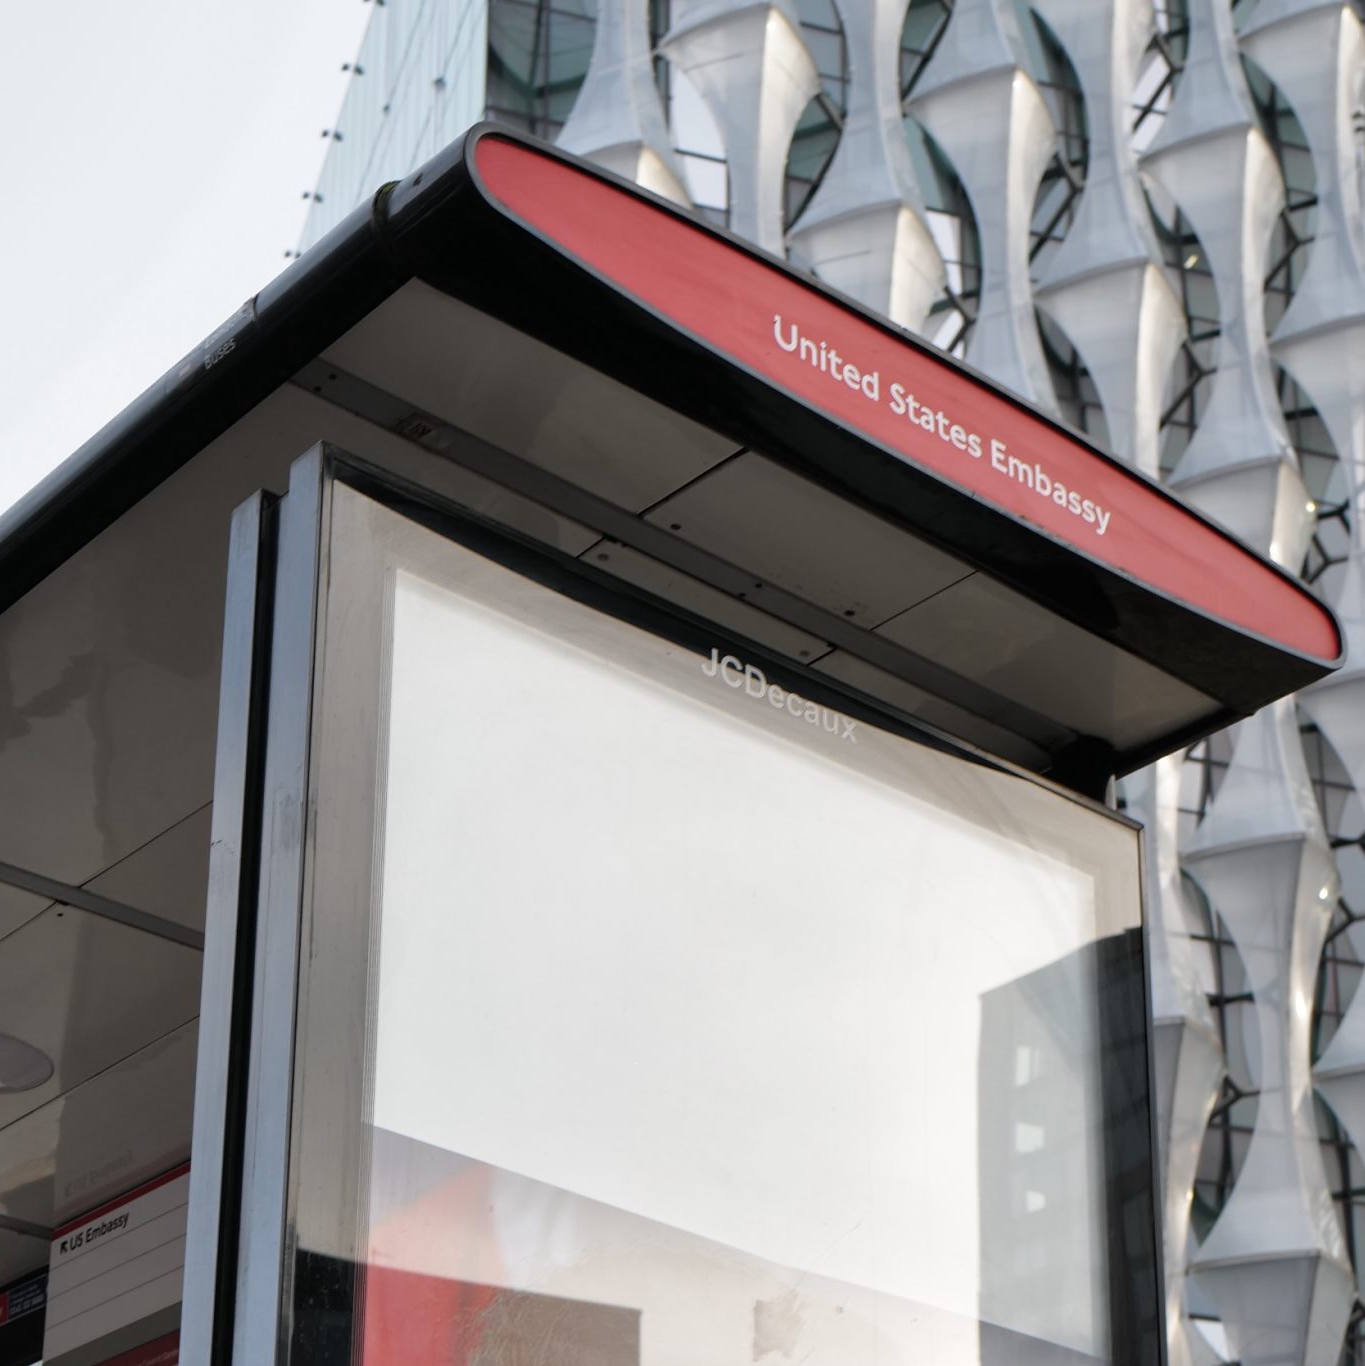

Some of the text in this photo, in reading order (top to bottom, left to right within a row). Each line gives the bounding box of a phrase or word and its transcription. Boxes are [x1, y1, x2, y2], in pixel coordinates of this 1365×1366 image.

[773, 315, 1113, 537] United States Embassy
[700, 646, 860, 745] JCDecaux
[69, 1212, 130, 1251] US Embassy
